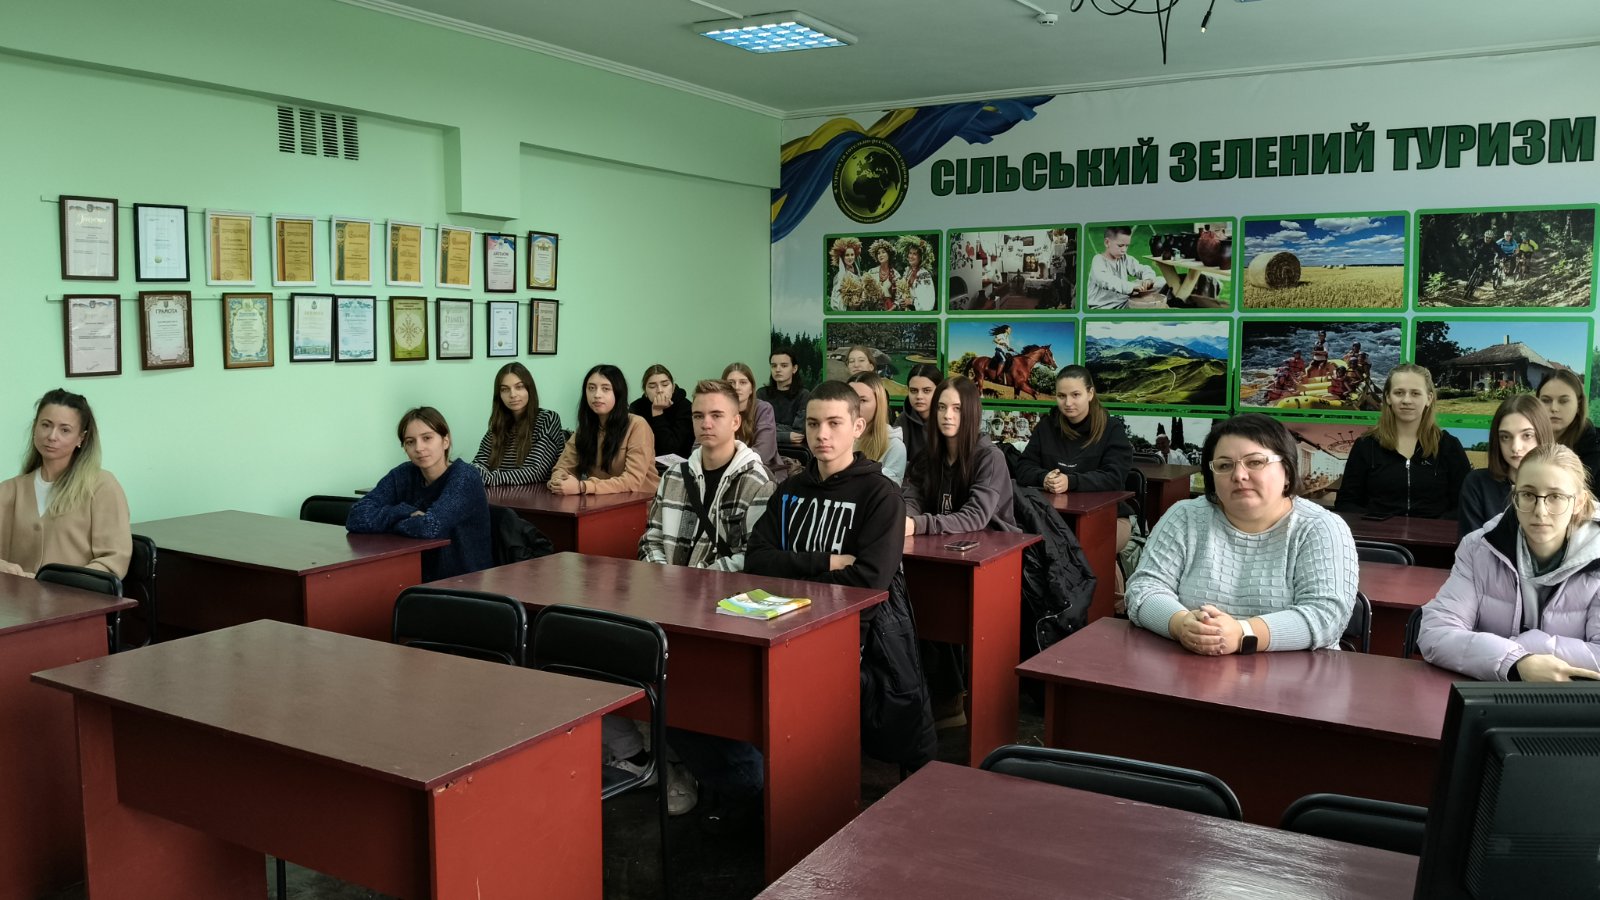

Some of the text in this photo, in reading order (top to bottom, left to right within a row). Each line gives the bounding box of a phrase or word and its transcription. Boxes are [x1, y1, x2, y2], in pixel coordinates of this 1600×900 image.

[930, 116, 1596, 197] СІЛЬСЬКИЙ ЗЕЛЕНИЙ ТУРИЗМ
